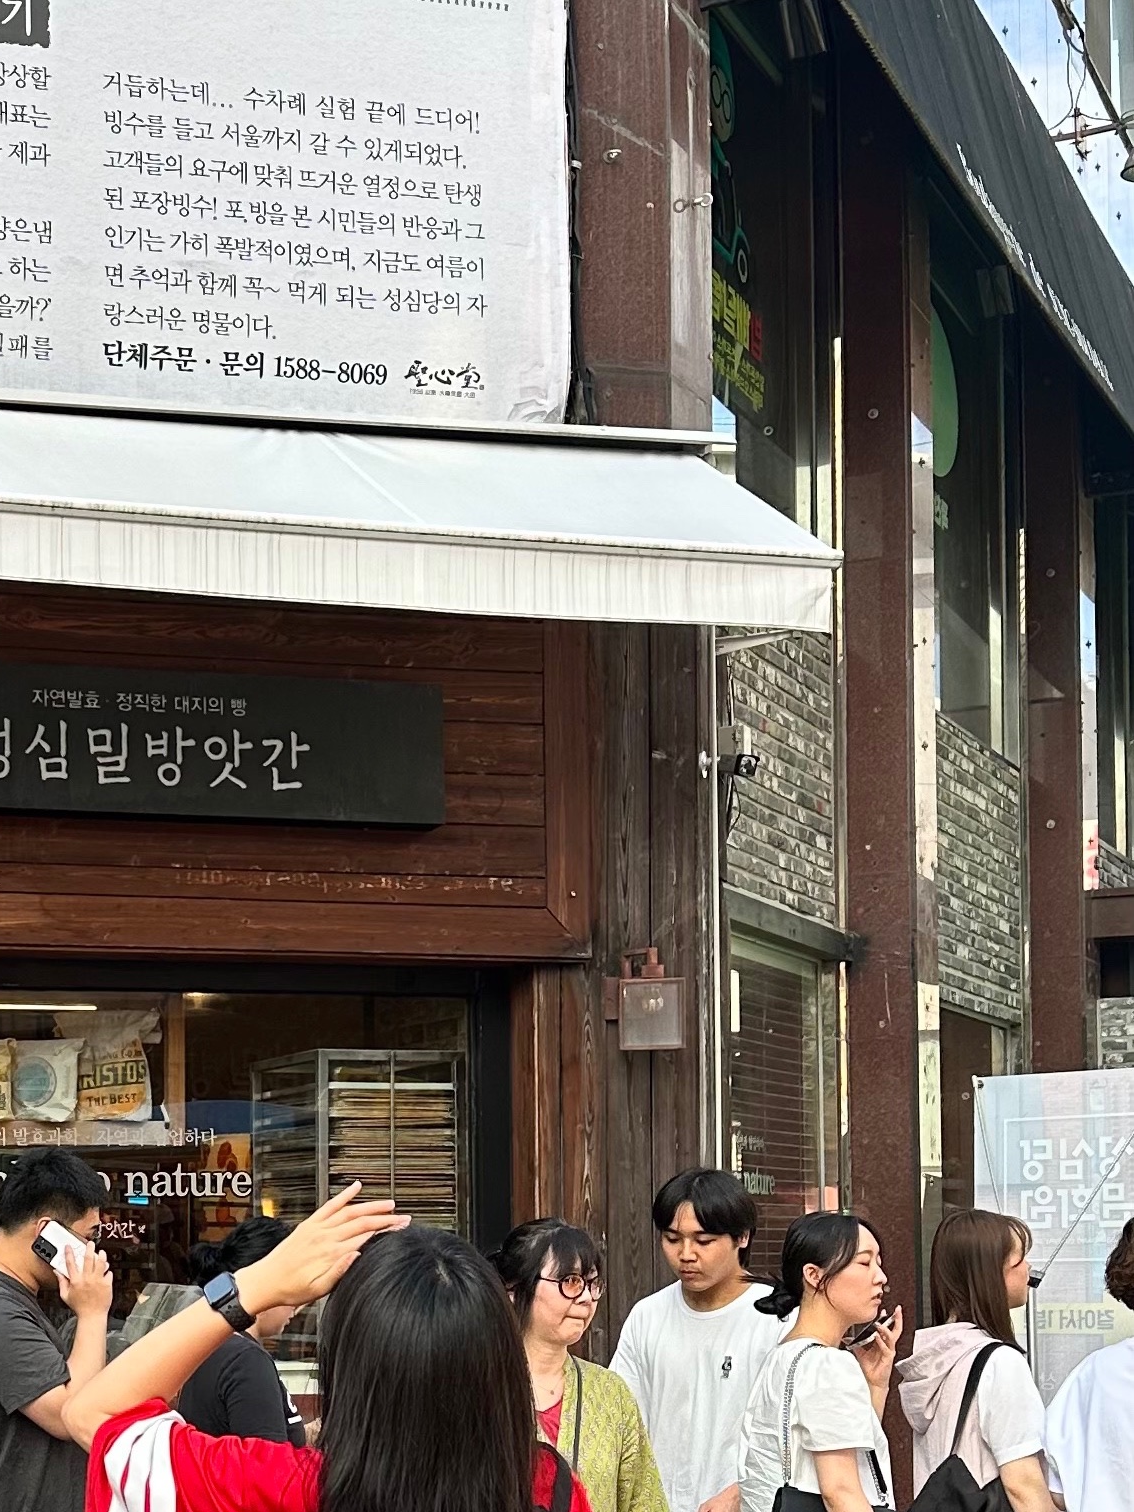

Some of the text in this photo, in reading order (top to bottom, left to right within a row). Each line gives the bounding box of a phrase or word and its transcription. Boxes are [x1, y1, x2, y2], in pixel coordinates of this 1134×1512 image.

[243, 87, 306, 117] 수차례
[315, 96, 355, 121] 실험
[365, 101, 406, 127] 끝에
[415, 108, 480, 135] 드디어!
[8, 141, 52, 168] 제과
[104, 110, 467, 170] 빙수를 들고 서울까지 갈 수 있게되었다.
[103, 150, 482, 208] 고객들의 요구에 맞춰 뜨거운 열정으로 탄생
[103, 187, 125, 211] 된
[130, 191, 218, 221] 포장빙수!
[291, 205, 313, 229] 본
[317, 208, 395, 238] 시민들의
[402, 215, 463, 243] 반응과
[465, 223, 486, 240] 그
[8, 256, 52, 283] 하는
[105, 225, 166, 253] 인기는
[170, 231, 208, 258] 가히
[363, 249, 422, 274] 지금도
[427, 254, 484, 282] 여름이
[105, 263, 125, 288] 면
[129, 266, 193, 295] 추억과
[197, 272, 237, 299] 함께
[288, 280, 327, 308] 먹게
[336, 285, 377, 310] 되는
[382, 288, 460, 317] 성심당의
[467, 294, 489, 319] 자
[104, 302, 277, 340] 랑스러운 명물이다.
[102, 340, 198, 373] 단체주문
[219, 352, 265, 380] 문의
[31, 689, 248, 717] 자연발효 정직한 대지의 빵
[124, 1162, 253, 1198] nature
